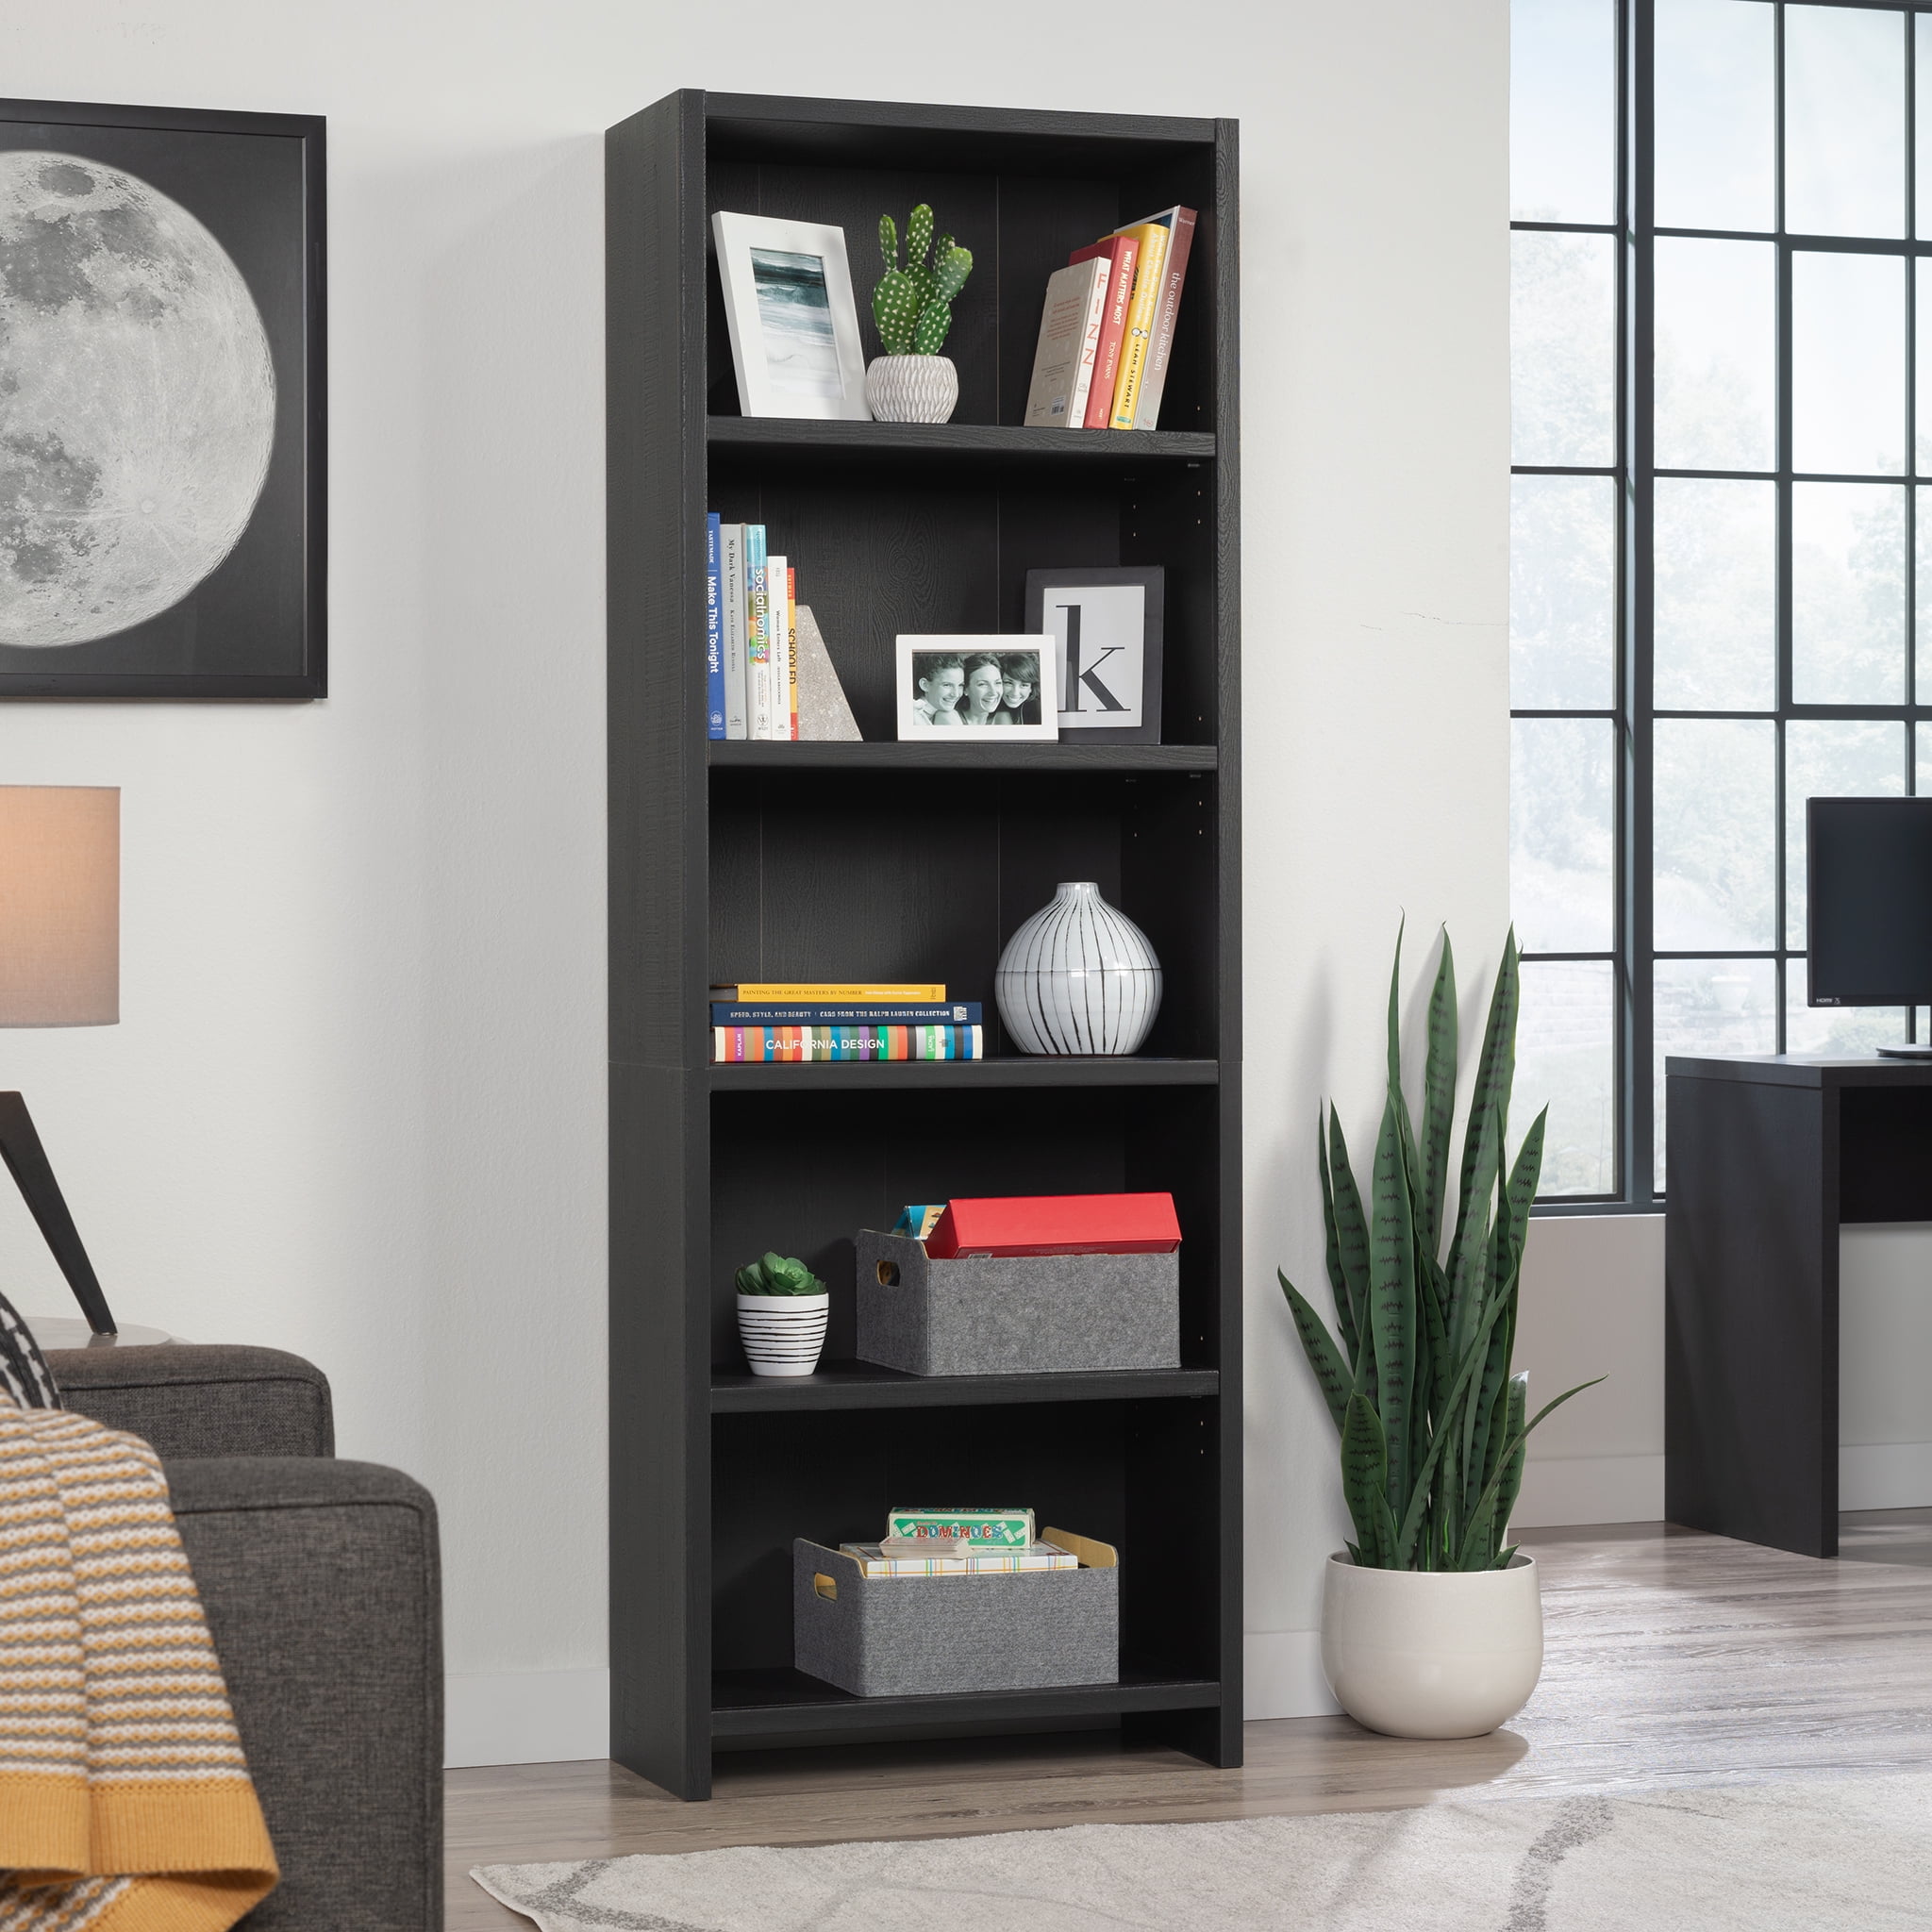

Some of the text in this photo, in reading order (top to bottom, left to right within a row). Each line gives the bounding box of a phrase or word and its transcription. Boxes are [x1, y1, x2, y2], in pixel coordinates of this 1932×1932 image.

[1157, 235, 1165, 256] What
[1112, 250, 1132, 325] WHAT MATTERS MOST
[1136, 233, 1158, 321] About Charlie Outlaw
[1149, 276, 1158, 298] Don't
[1144, 300, 1153, 324] Know
[1154, 272, 1180, 371] the outdoor kitchen
[1104, 358, 1112, 379] EVANS
[1124, 369, 1135, 408] STEWART
[726, 539, 734, 549] My
[708, 575, 719, 673] Make This Tonight
[756, 569, 768, 659] socialnomics
[1056, 605, 1131, 712] k
[841, 1039, 885, 1049] DESIGN
[916, 1524, 1005, 1540] DOMINOES
